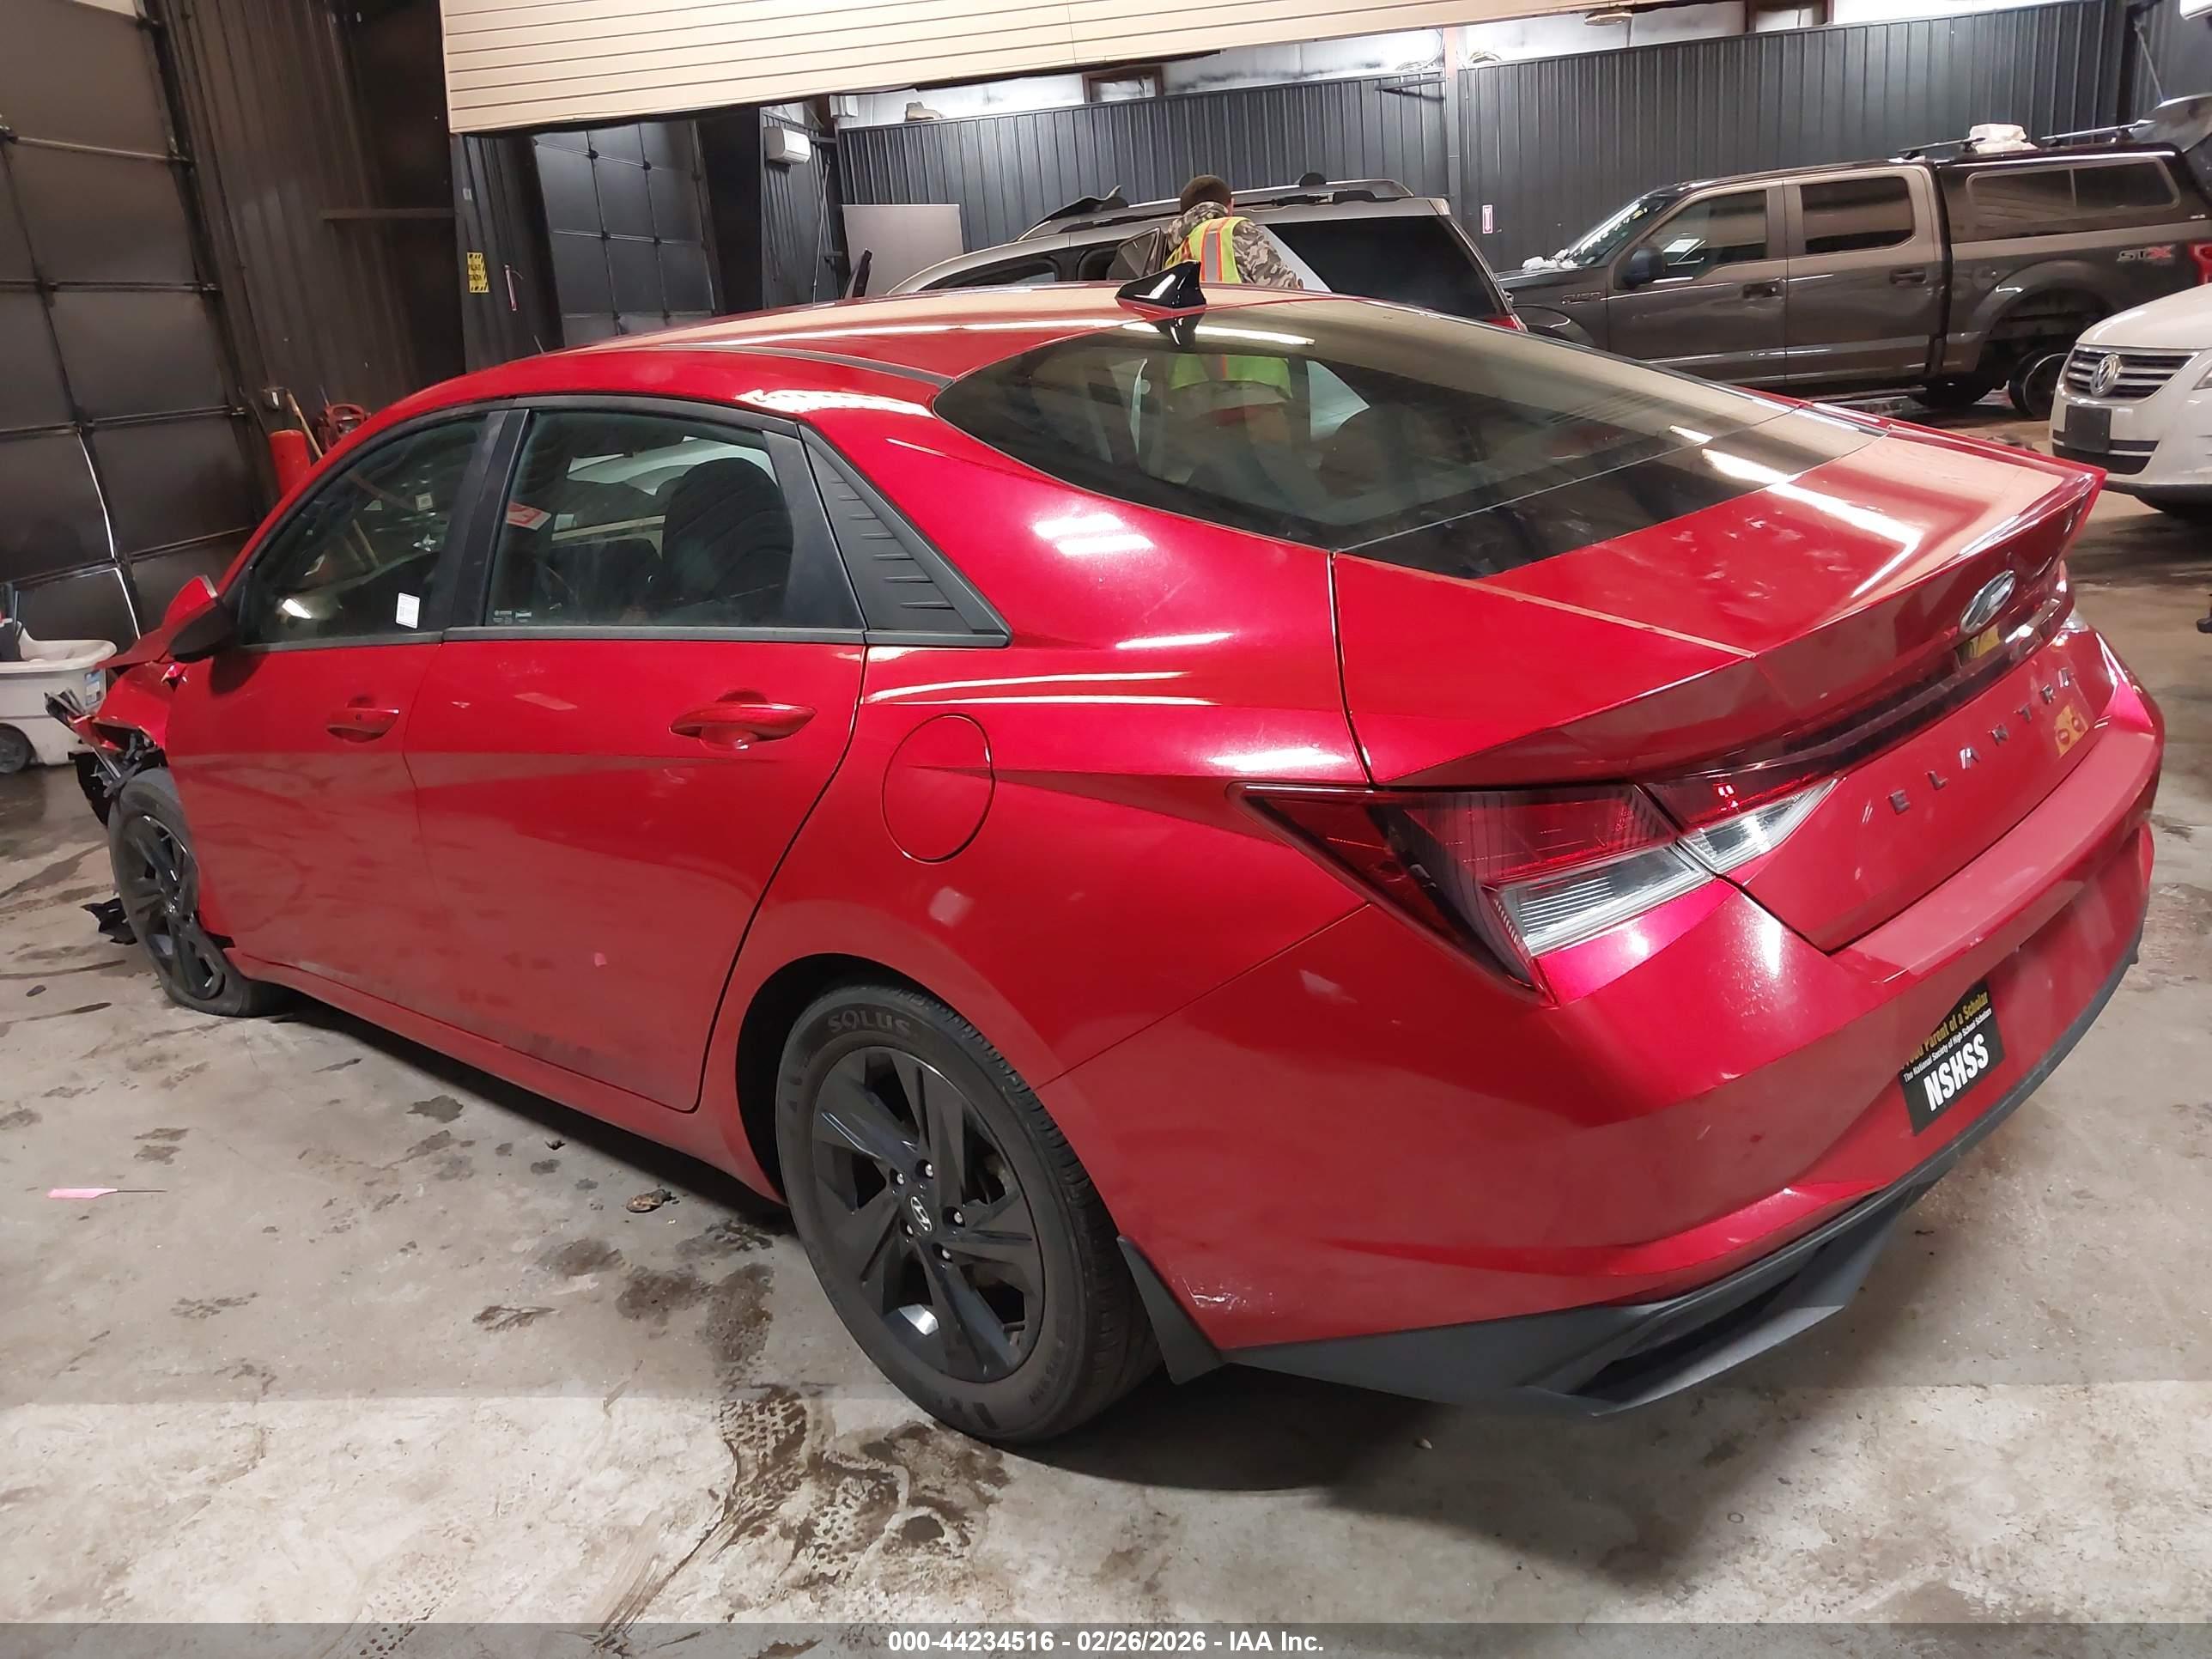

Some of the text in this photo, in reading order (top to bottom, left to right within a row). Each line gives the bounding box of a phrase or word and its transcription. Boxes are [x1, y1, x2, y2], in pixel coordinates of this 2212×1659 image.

[1887, 667, 2072, 815] ELANTRA
[827, 1009, 911, 1035] SOLUS
[1903, 1008, 1992, 1083] The National Society of High School Scholars
[1949, 1014, 1958, 1031] of
[1958, 1013, 1964, 1025] a
[1963, 992, 1989, 1020] Scholar
[1923, 1033, 1990, 1111] NSHSS
